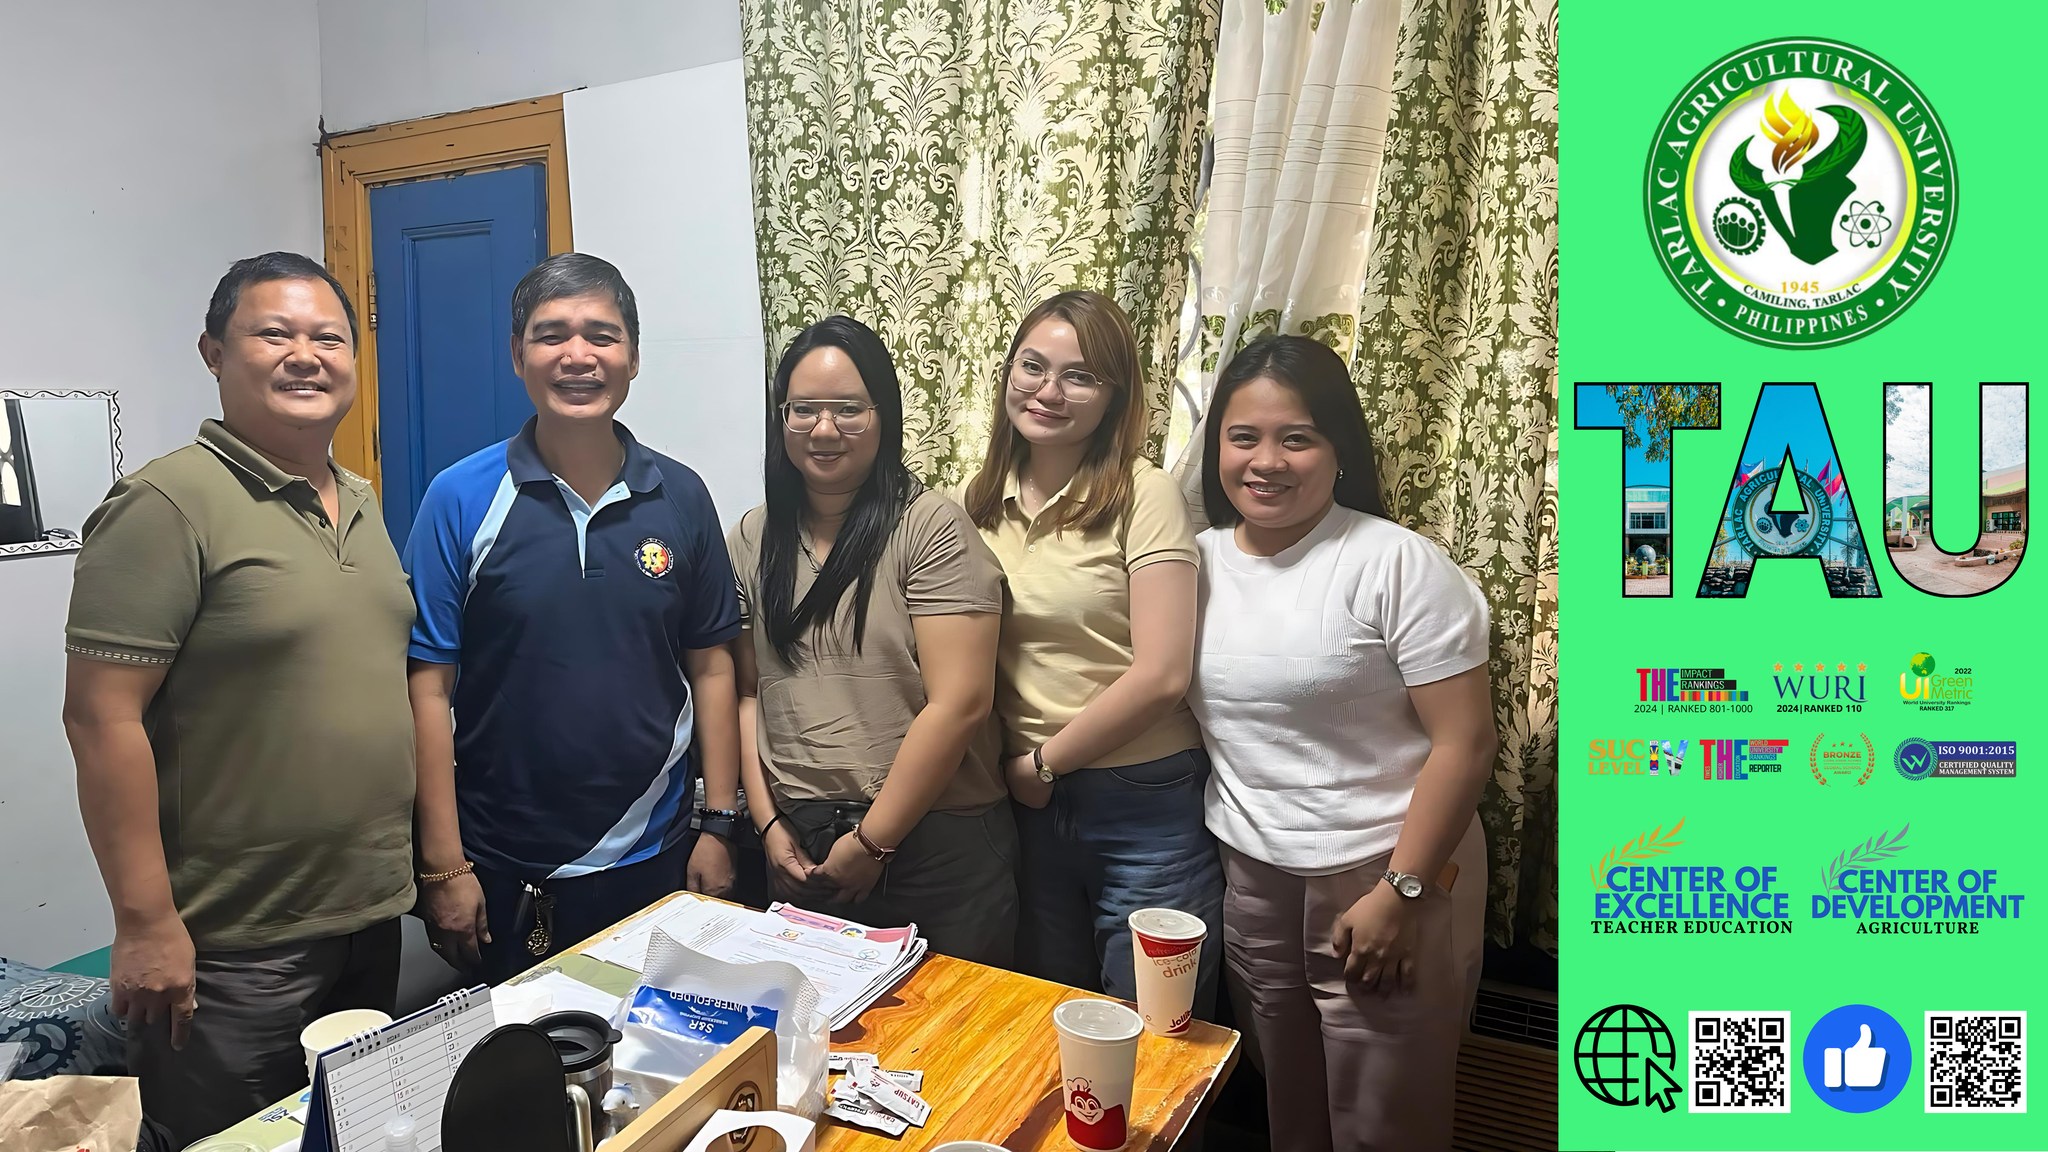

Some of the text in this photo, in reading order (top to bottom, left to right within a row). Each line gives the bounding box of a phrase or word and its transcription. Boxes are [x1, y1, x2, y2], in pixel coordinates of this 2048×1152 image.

[1163, 958, 1197, 978] drink
[689, 1019, 714, 1033] S&R
[894, 1089, 920, 1109] CATSUP
